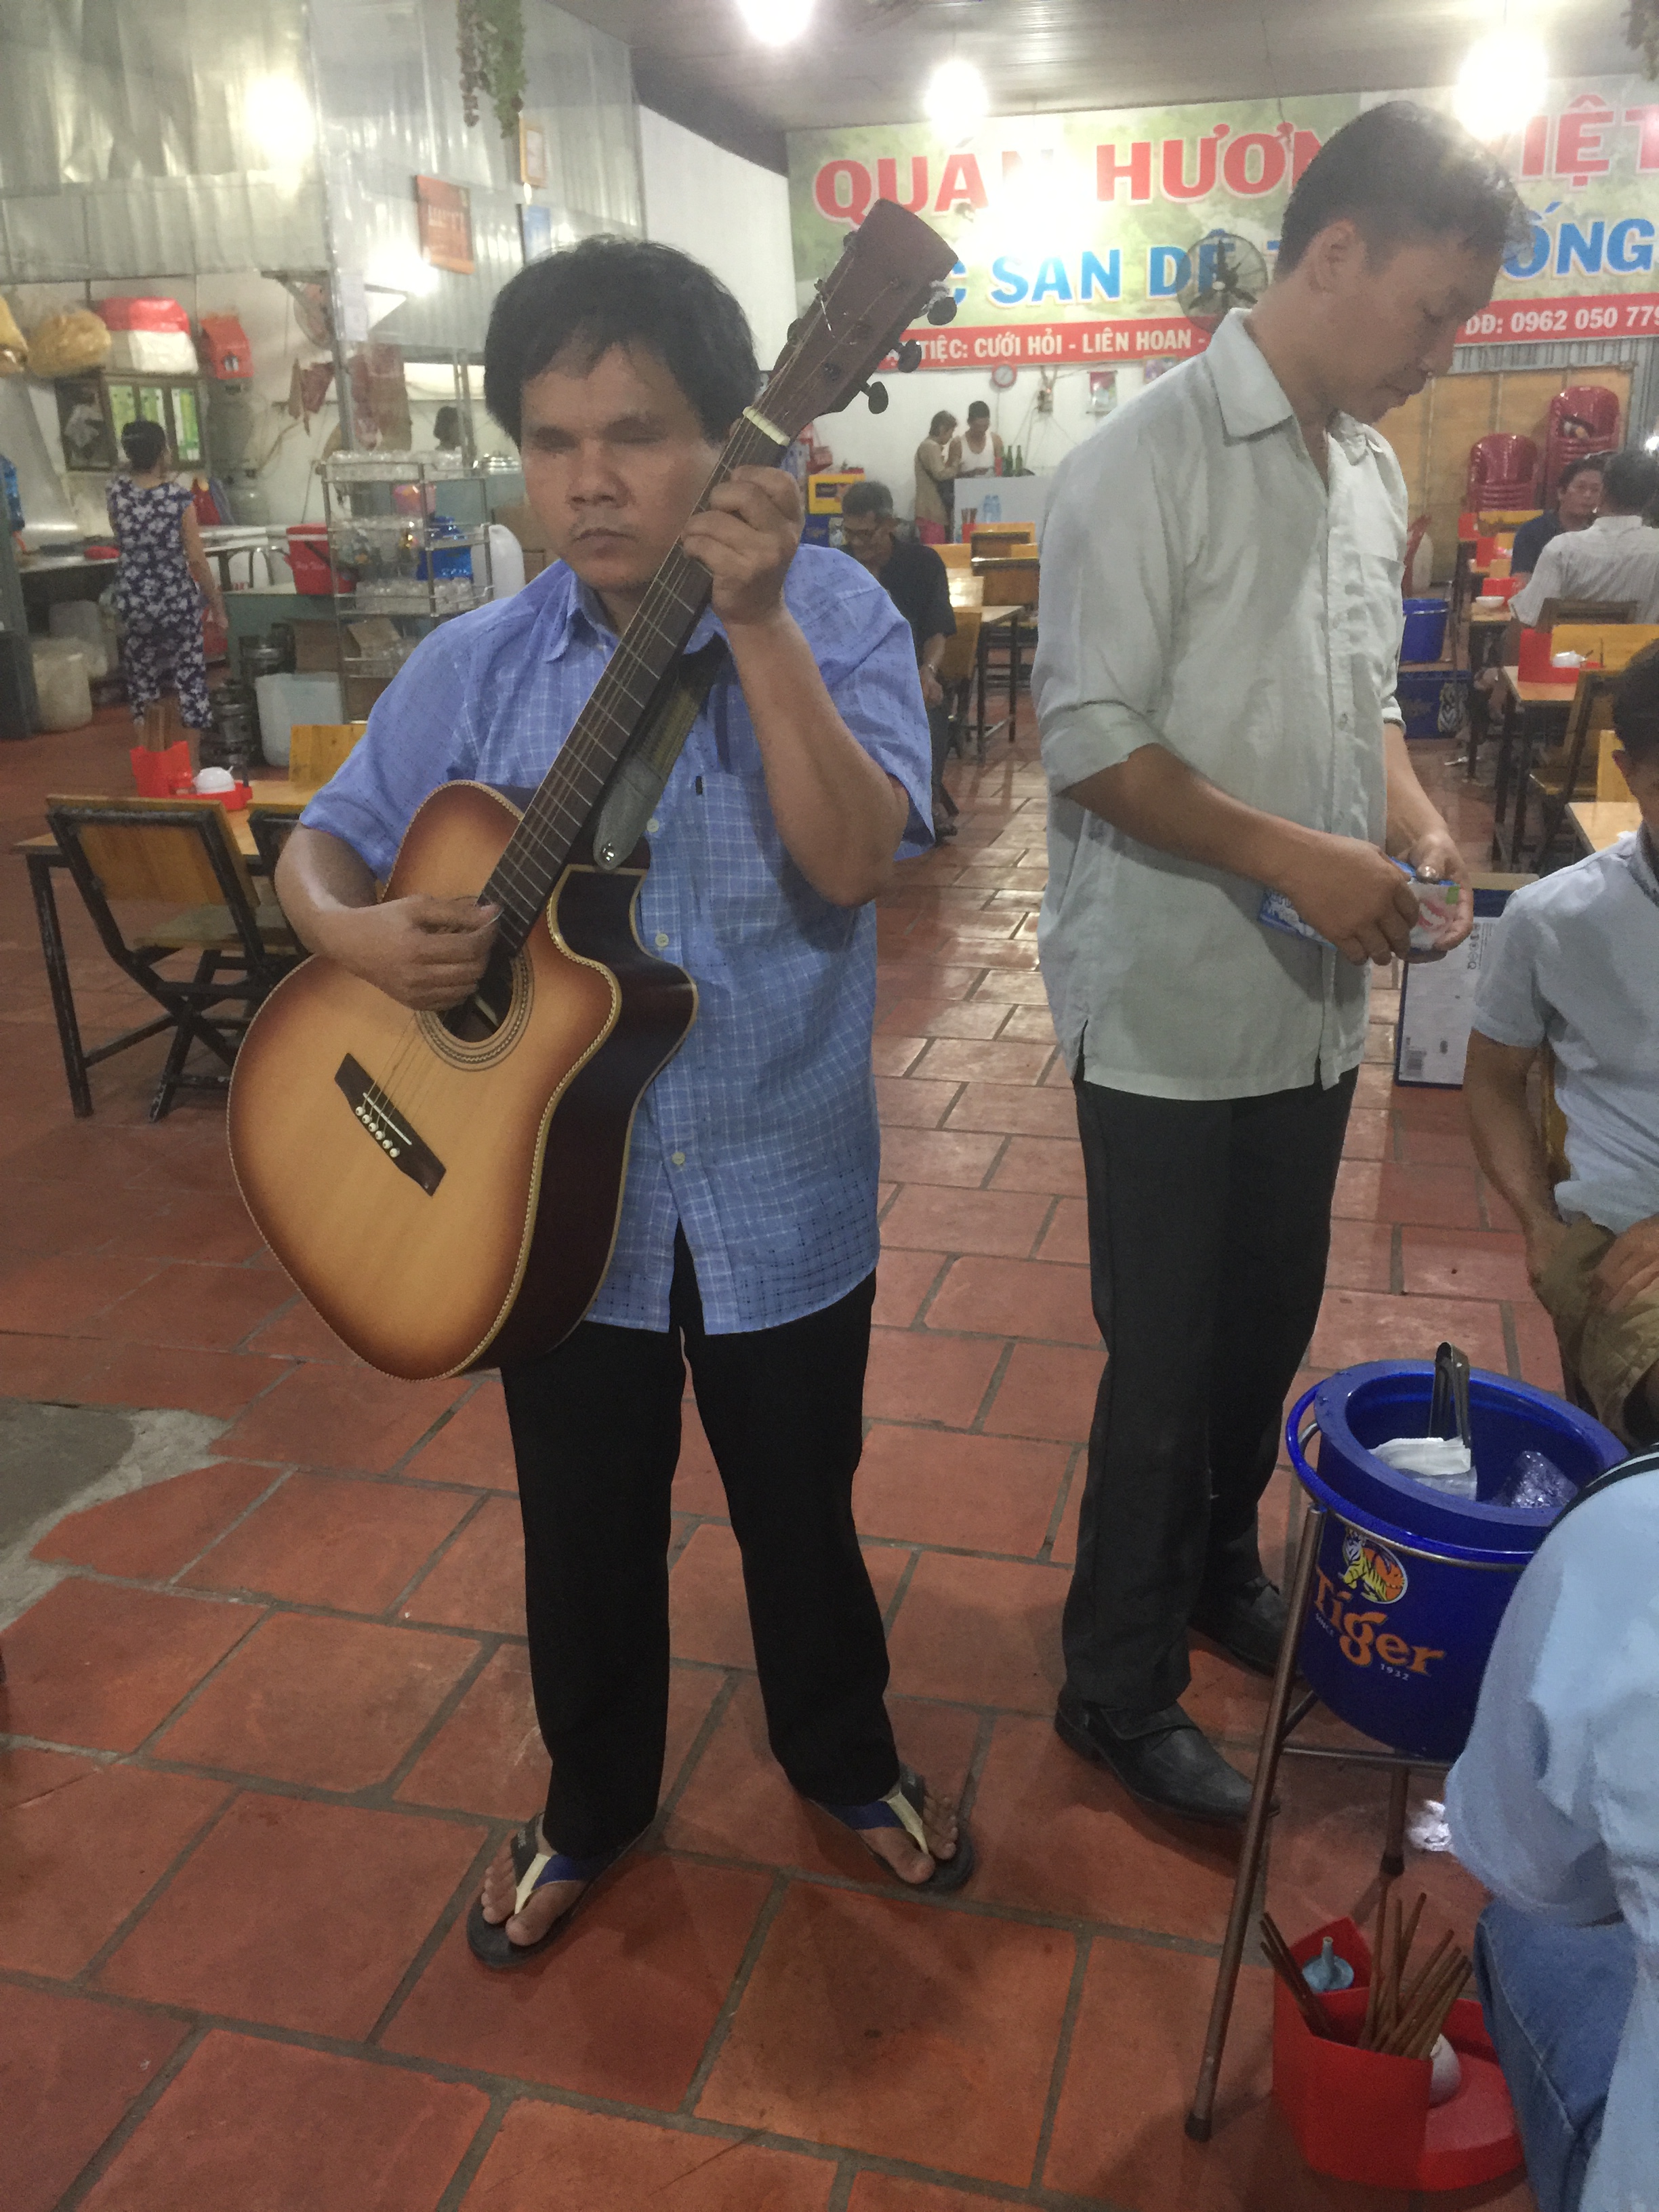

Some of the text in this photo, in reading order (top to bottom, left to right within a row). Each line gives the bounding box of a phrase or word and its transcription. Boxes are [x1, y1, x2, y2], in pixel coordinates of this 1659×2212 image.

[1502, 201, 1655, 278] ỐNG
[974, 331, 1021, 358] CƯỚI
[1027, 327, 1063, 356] HỎI
[1082, 327, 1130, 354] LIÊN
[1136, 329, 1191, 352] HOAN
[1511, 310, 1568, 333] 0962
[1575, 306, 1618, 330] 050
[1314, 1563, 1446, 1677] Tiger
[1380, 1662, 1410, 1681] 1932
